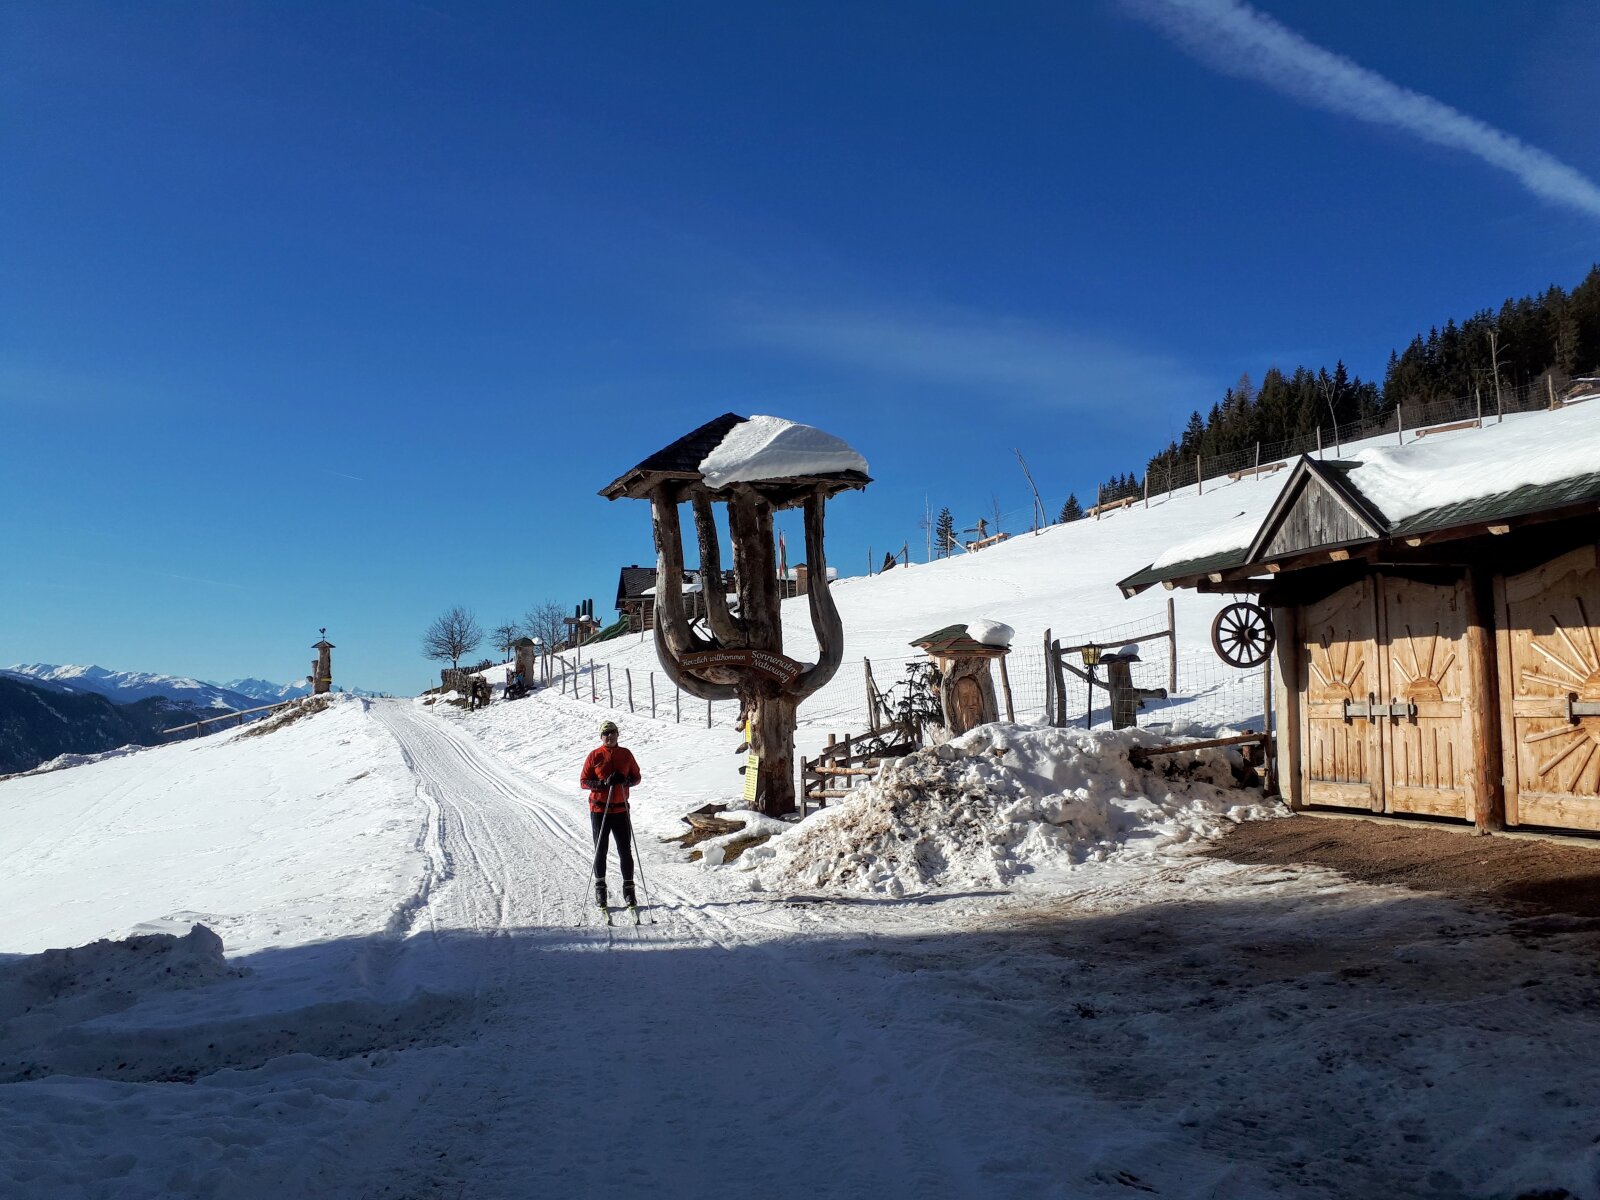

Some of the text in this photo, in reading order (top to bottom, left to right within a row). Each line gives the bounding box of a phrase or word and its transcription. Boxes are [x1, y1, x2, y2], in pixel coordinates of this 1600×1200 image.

[681, 653, 746, 666] Herzlich willkommen
[751, 650, 798, 677] Sonnenalm
[751, 659, 790, 684] Naturweg
